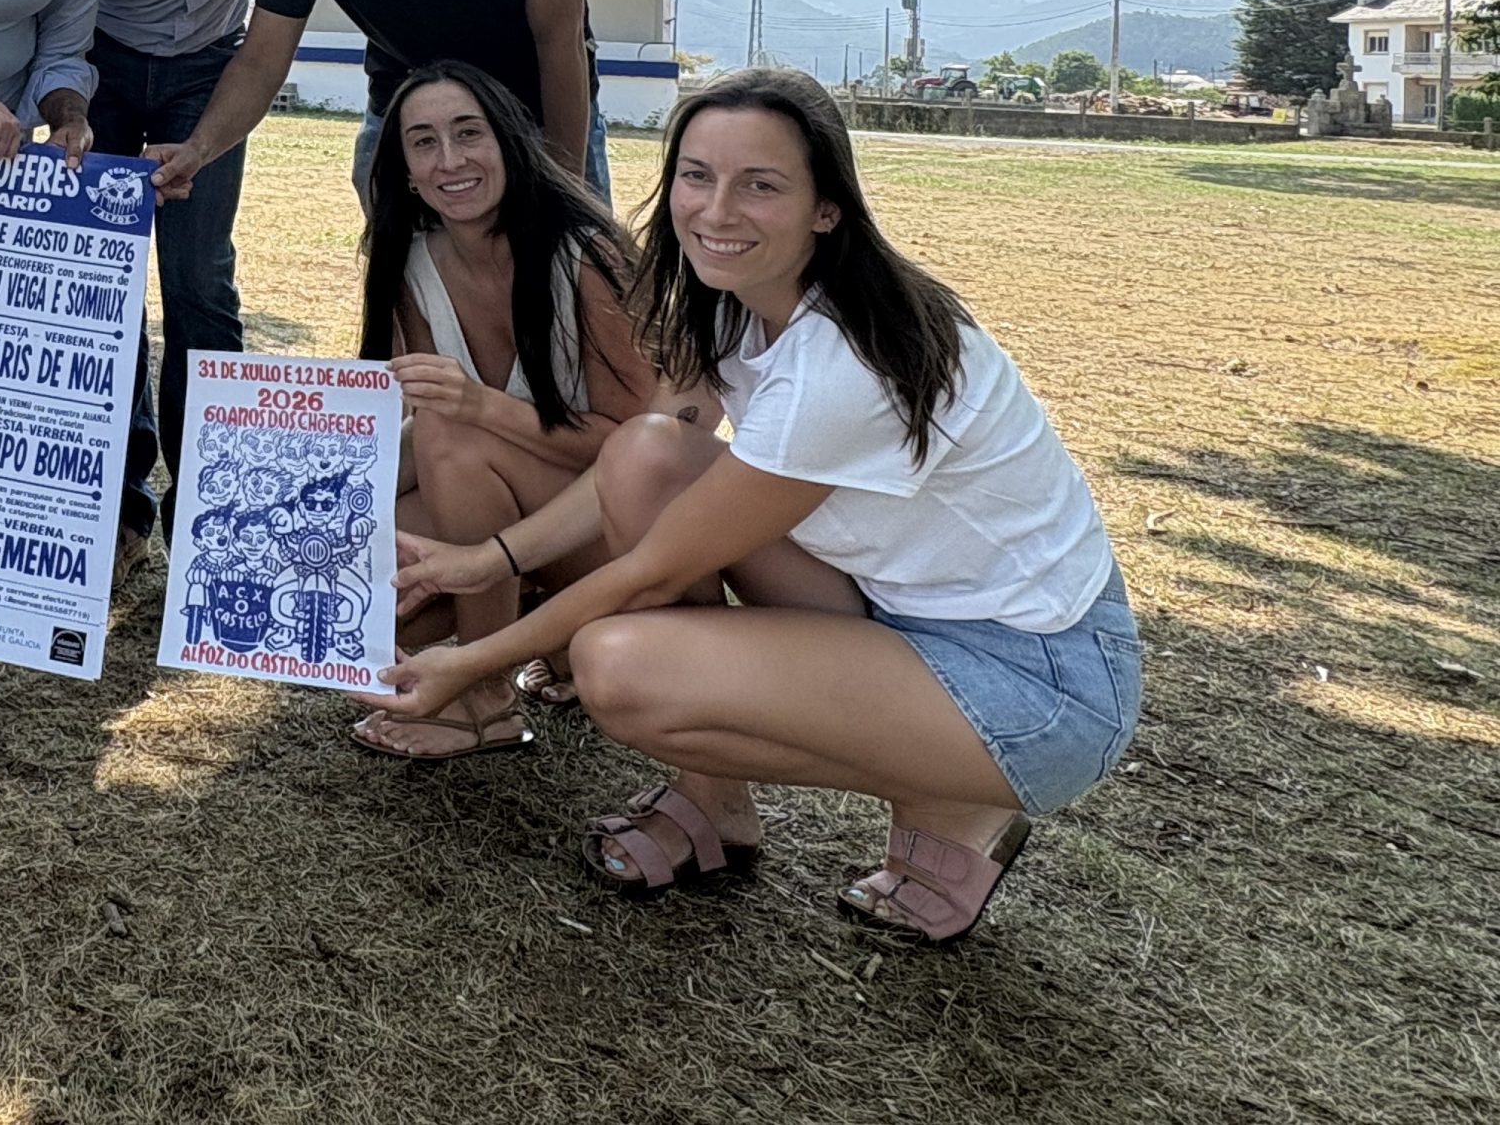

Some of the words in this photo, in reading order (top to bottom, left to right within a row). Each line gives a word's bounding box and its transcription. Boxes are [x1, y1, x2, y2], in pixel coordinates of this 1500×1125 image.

[12, 225, 68, 252] AGOSTO
[73, 234, 94, 257] DE
[98, 238, 134, 263] 2026
[57, 267, 74, 278] con
[117, 273, 129, 286] de
[7, 273, 46, 311] VEIGA
[51, 280, 63, 314] E
[45, 331, 94, 349] VERBENA
[99, 343, 119, 353] con
[37, 347, 64, 387] DE
[68, 352, 113, 397] NOIA
[198, 359, 218, 378] 31
[221, 361, 238, 380] DE
[240, 363, 281, 382] XULLO
[284, 365, 292, 383] E
[317, 368, 334, 386] DE
[337, 369, 389, 390] AGOSTO
[258, 388, 323, 411] 2026
[268, 409, 296, 430] DOS
[88, 436, 110, 449] con
[33, 441, 103, 488] BOMBA
[70, 533, 94, 545] con
[234, 599, 249, 614] O
[215, 608, 267, 628] CASTELO
[8, 636, 41, 650] GALICIA
[180, 641, 225, 666] ALFOZ
[226, 652, 248, 669] DO
